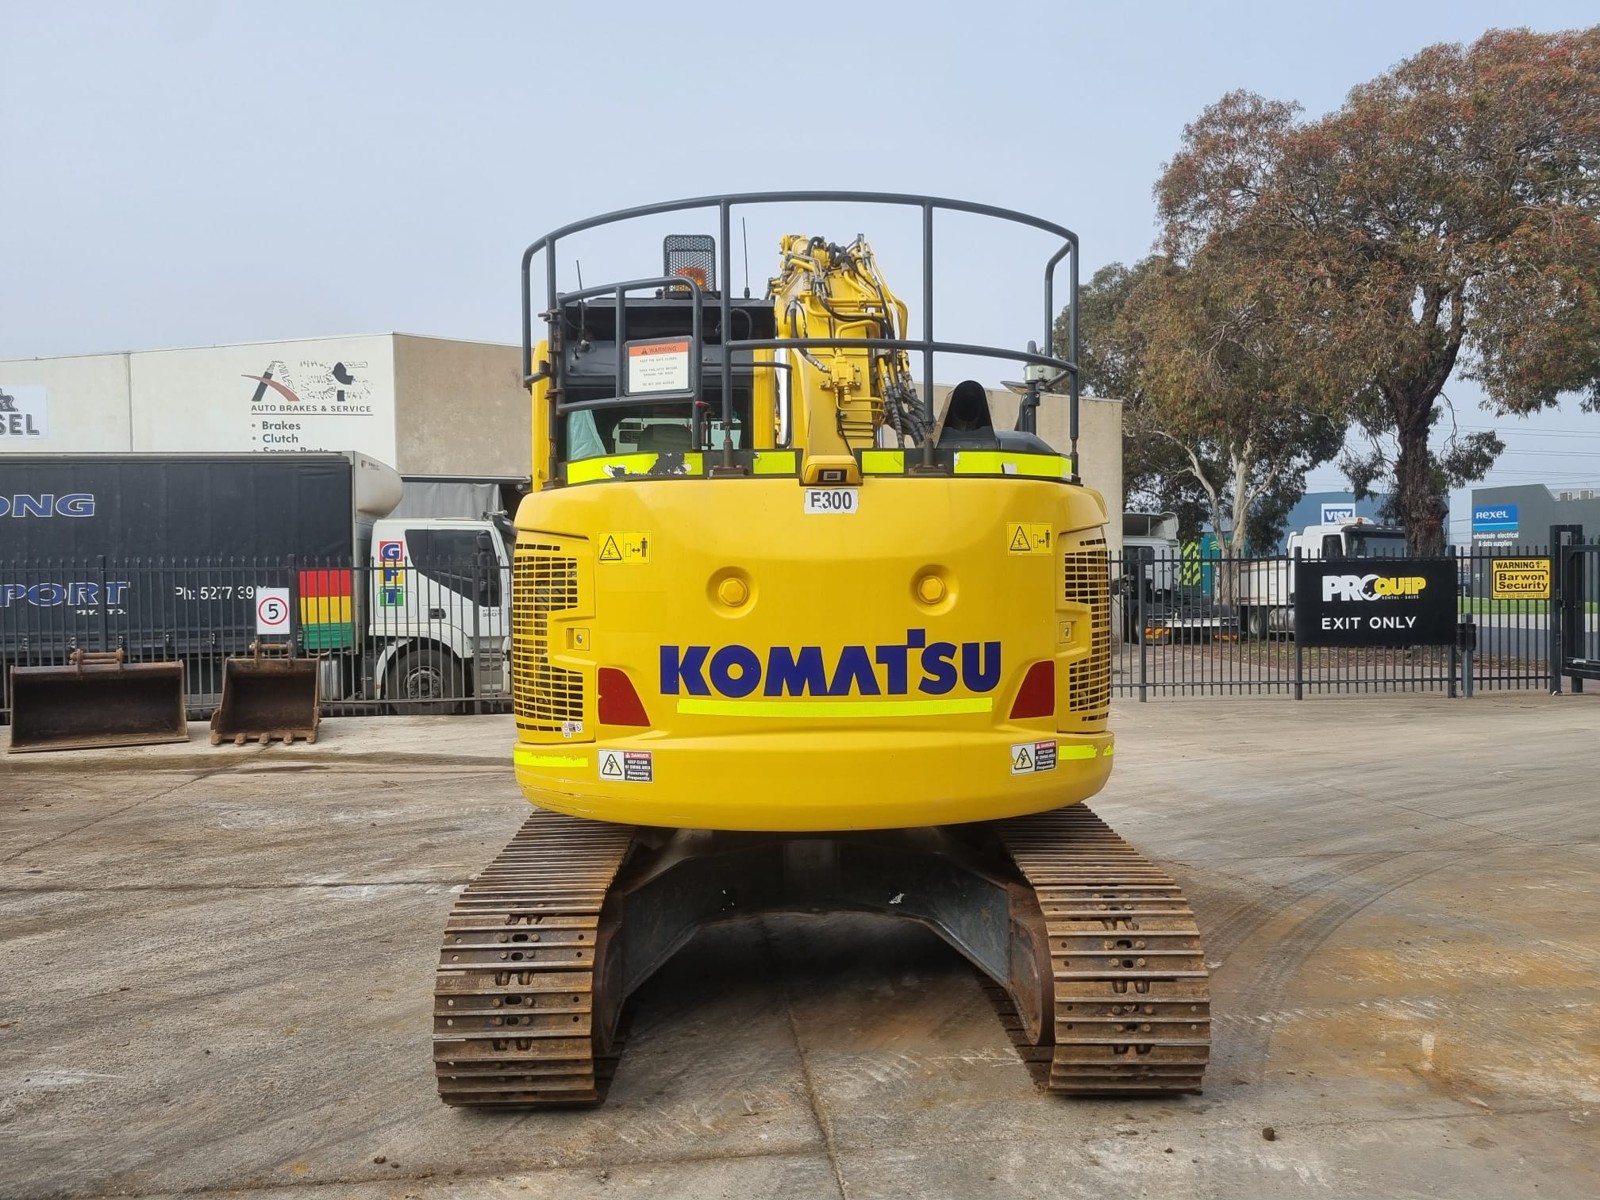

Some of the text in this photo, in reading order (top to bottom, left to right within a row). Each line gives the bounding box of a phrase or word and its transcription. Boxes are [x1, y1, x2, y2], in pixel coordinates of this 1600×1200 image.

[649, 346, 677, 354] WARNING
[262, 421, 301, 430] Brakes
[262, 434, 299, 443] Clutch
[0, 493, 95, 517] NG
[1499, 573, 1545, 581] Barwon
[1499, 581, 1548, 592] Security
[175, 586, 195, 600] Ph:
[200, 586, 233, 600] 5277
[268, 604, 279, 619] 5
[1321, 616, 1416, 630] EXIT ONLY
[659, 628, 1001, 698] KOMATSU
